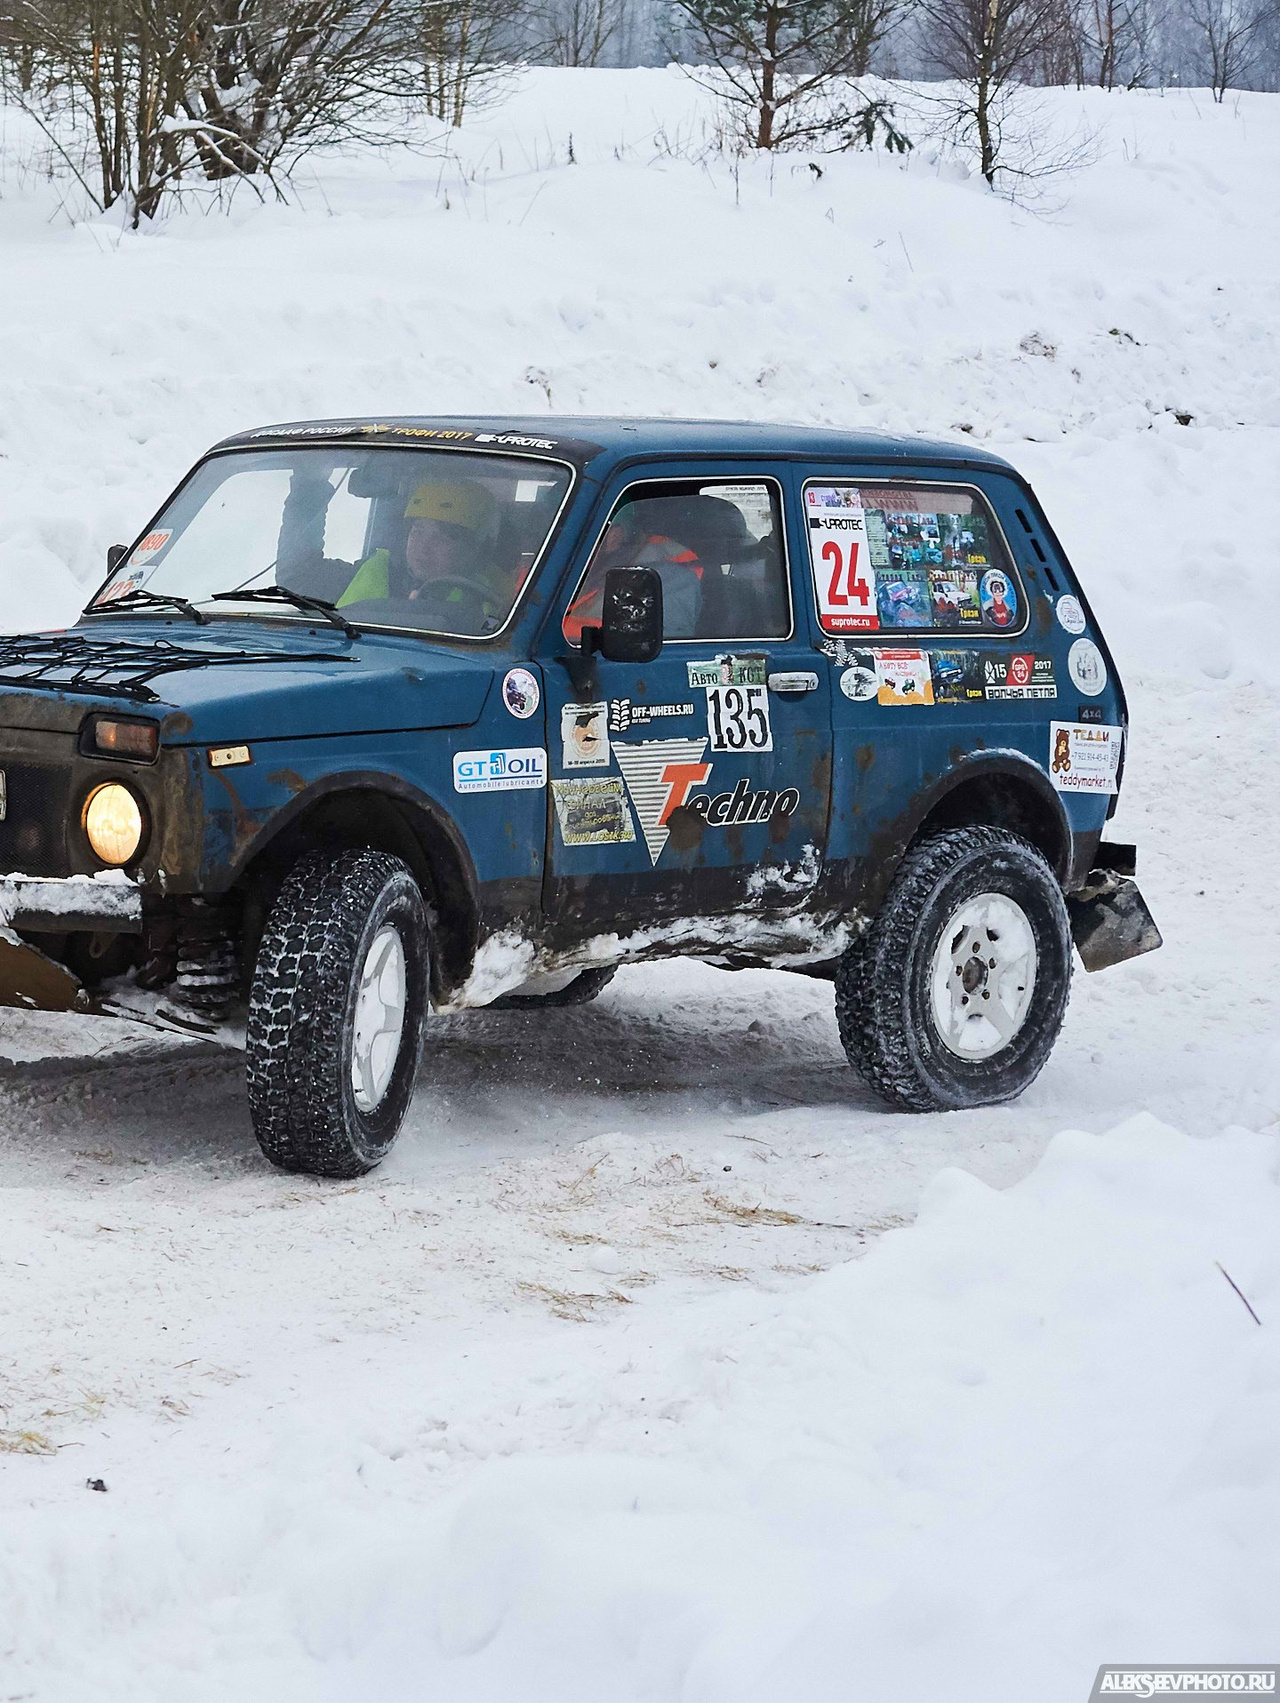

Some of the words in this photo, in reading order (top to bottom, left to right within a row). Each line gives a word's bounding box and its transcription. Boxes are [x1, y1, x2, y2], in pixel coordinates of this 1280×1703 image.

[440, 430, 472, 441] 2017
[822, 541, 870, 606] 24
[831, 617, 871, 628] suprotec.ru
[994, 663, 1007, 679] 15
[1034, 660, 1052, 670] 2017
[1027, 688, 1056, 698] ПЕТЛЯ
[631, 703, 694, 718] OFF-WHEELS.RU
[708, 689, 769, 749] 135
[1073, 728, 1109, 742] ТЕДДИ
[458, 761, 487, 777] GT
[508, 758, 543, 774] OIL
[458, 782, 501, 790] Automobile
[503, 779, 543, 787] lubricants
[658, 763, 801, 828] Techno
